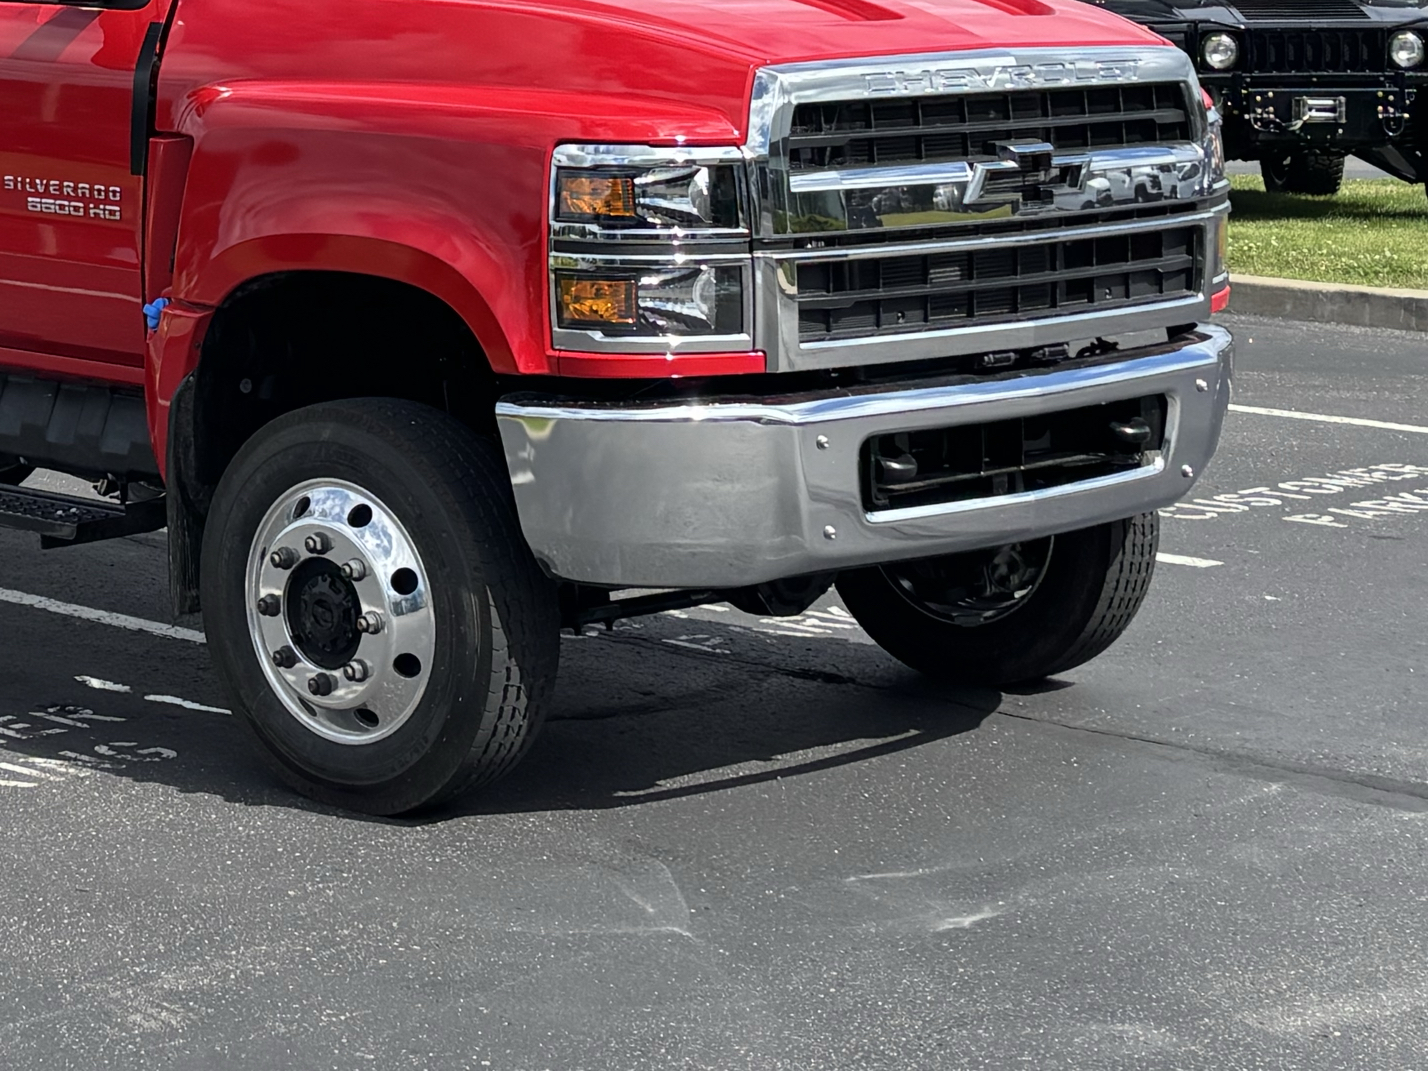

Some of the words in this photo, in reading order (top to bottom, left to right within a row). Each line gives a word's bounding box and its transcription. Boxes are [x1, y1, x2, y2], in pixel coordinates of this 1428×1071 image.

[860, 58, 1144, 96] CHEVROLET
[3, 175, 121, 201] SILVERADO
[89, 203, 121, 220] HD
